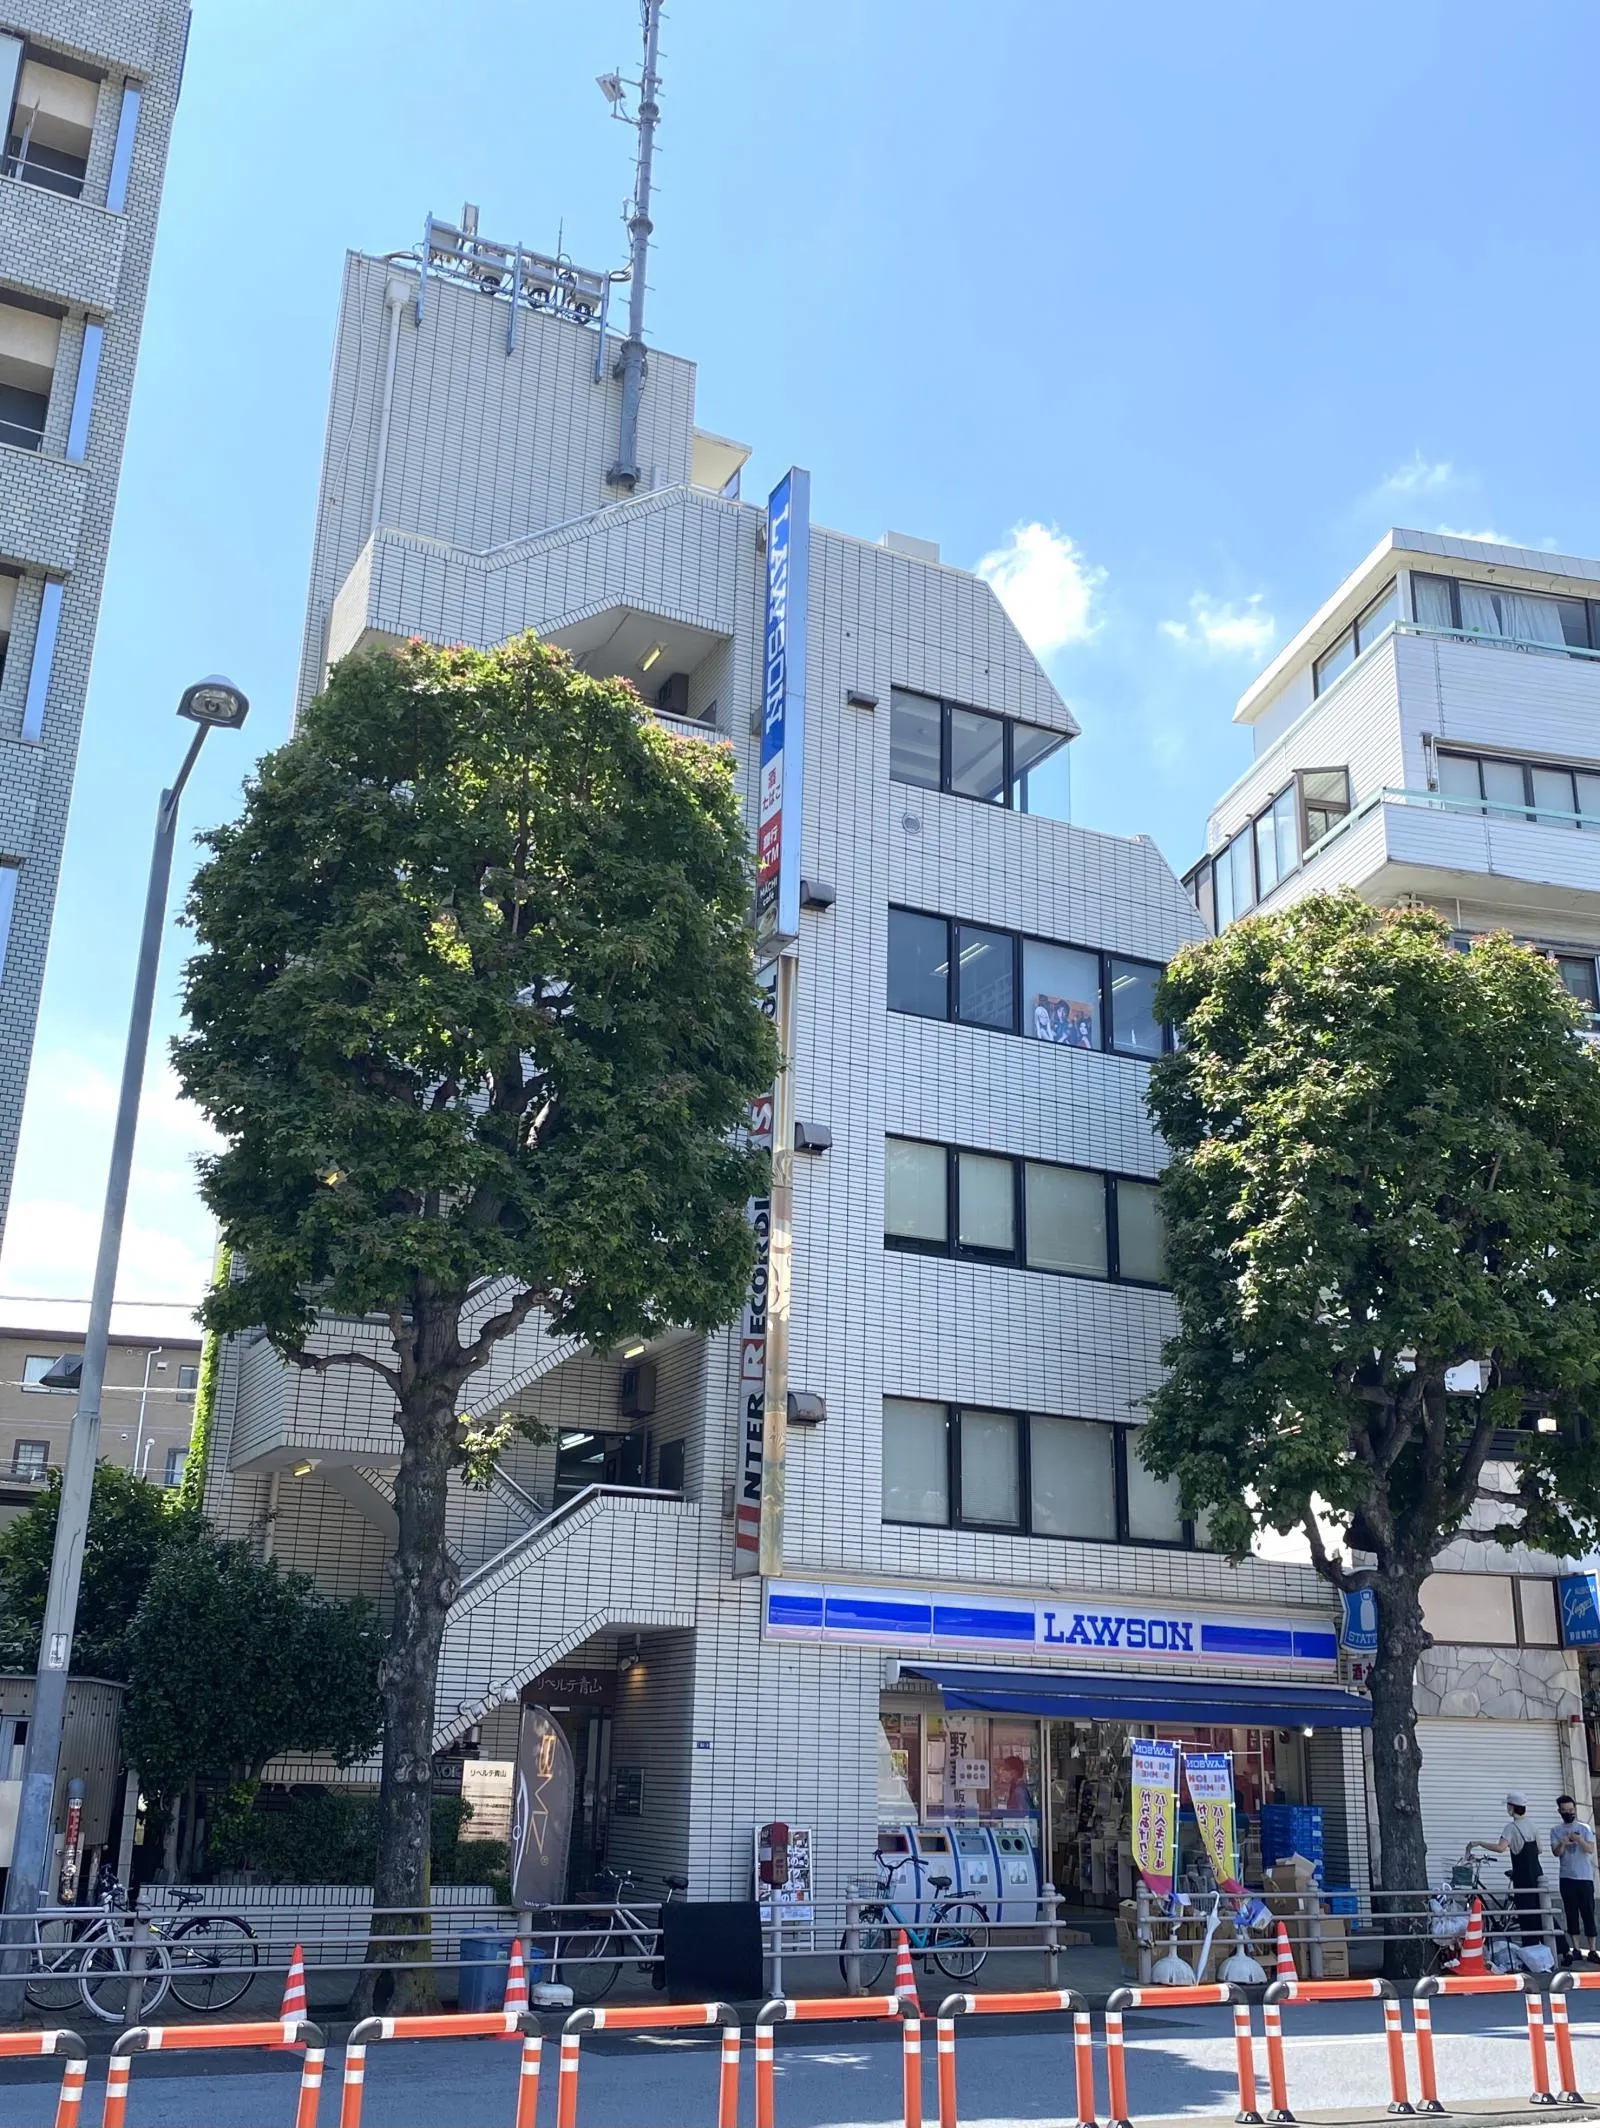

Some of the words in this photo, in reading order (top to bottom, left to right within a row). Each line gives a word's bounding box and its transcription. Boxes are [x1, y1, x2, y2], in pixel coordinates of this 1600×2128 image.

[766, 503, 789, 735] LAWSON
[762, 784, 781, 812] たばこ
[760, 844, 779, 872] ATM
[759, 876, 778, 899] MACHI
[1044, 1612, 1194, 1651] LAWSON
